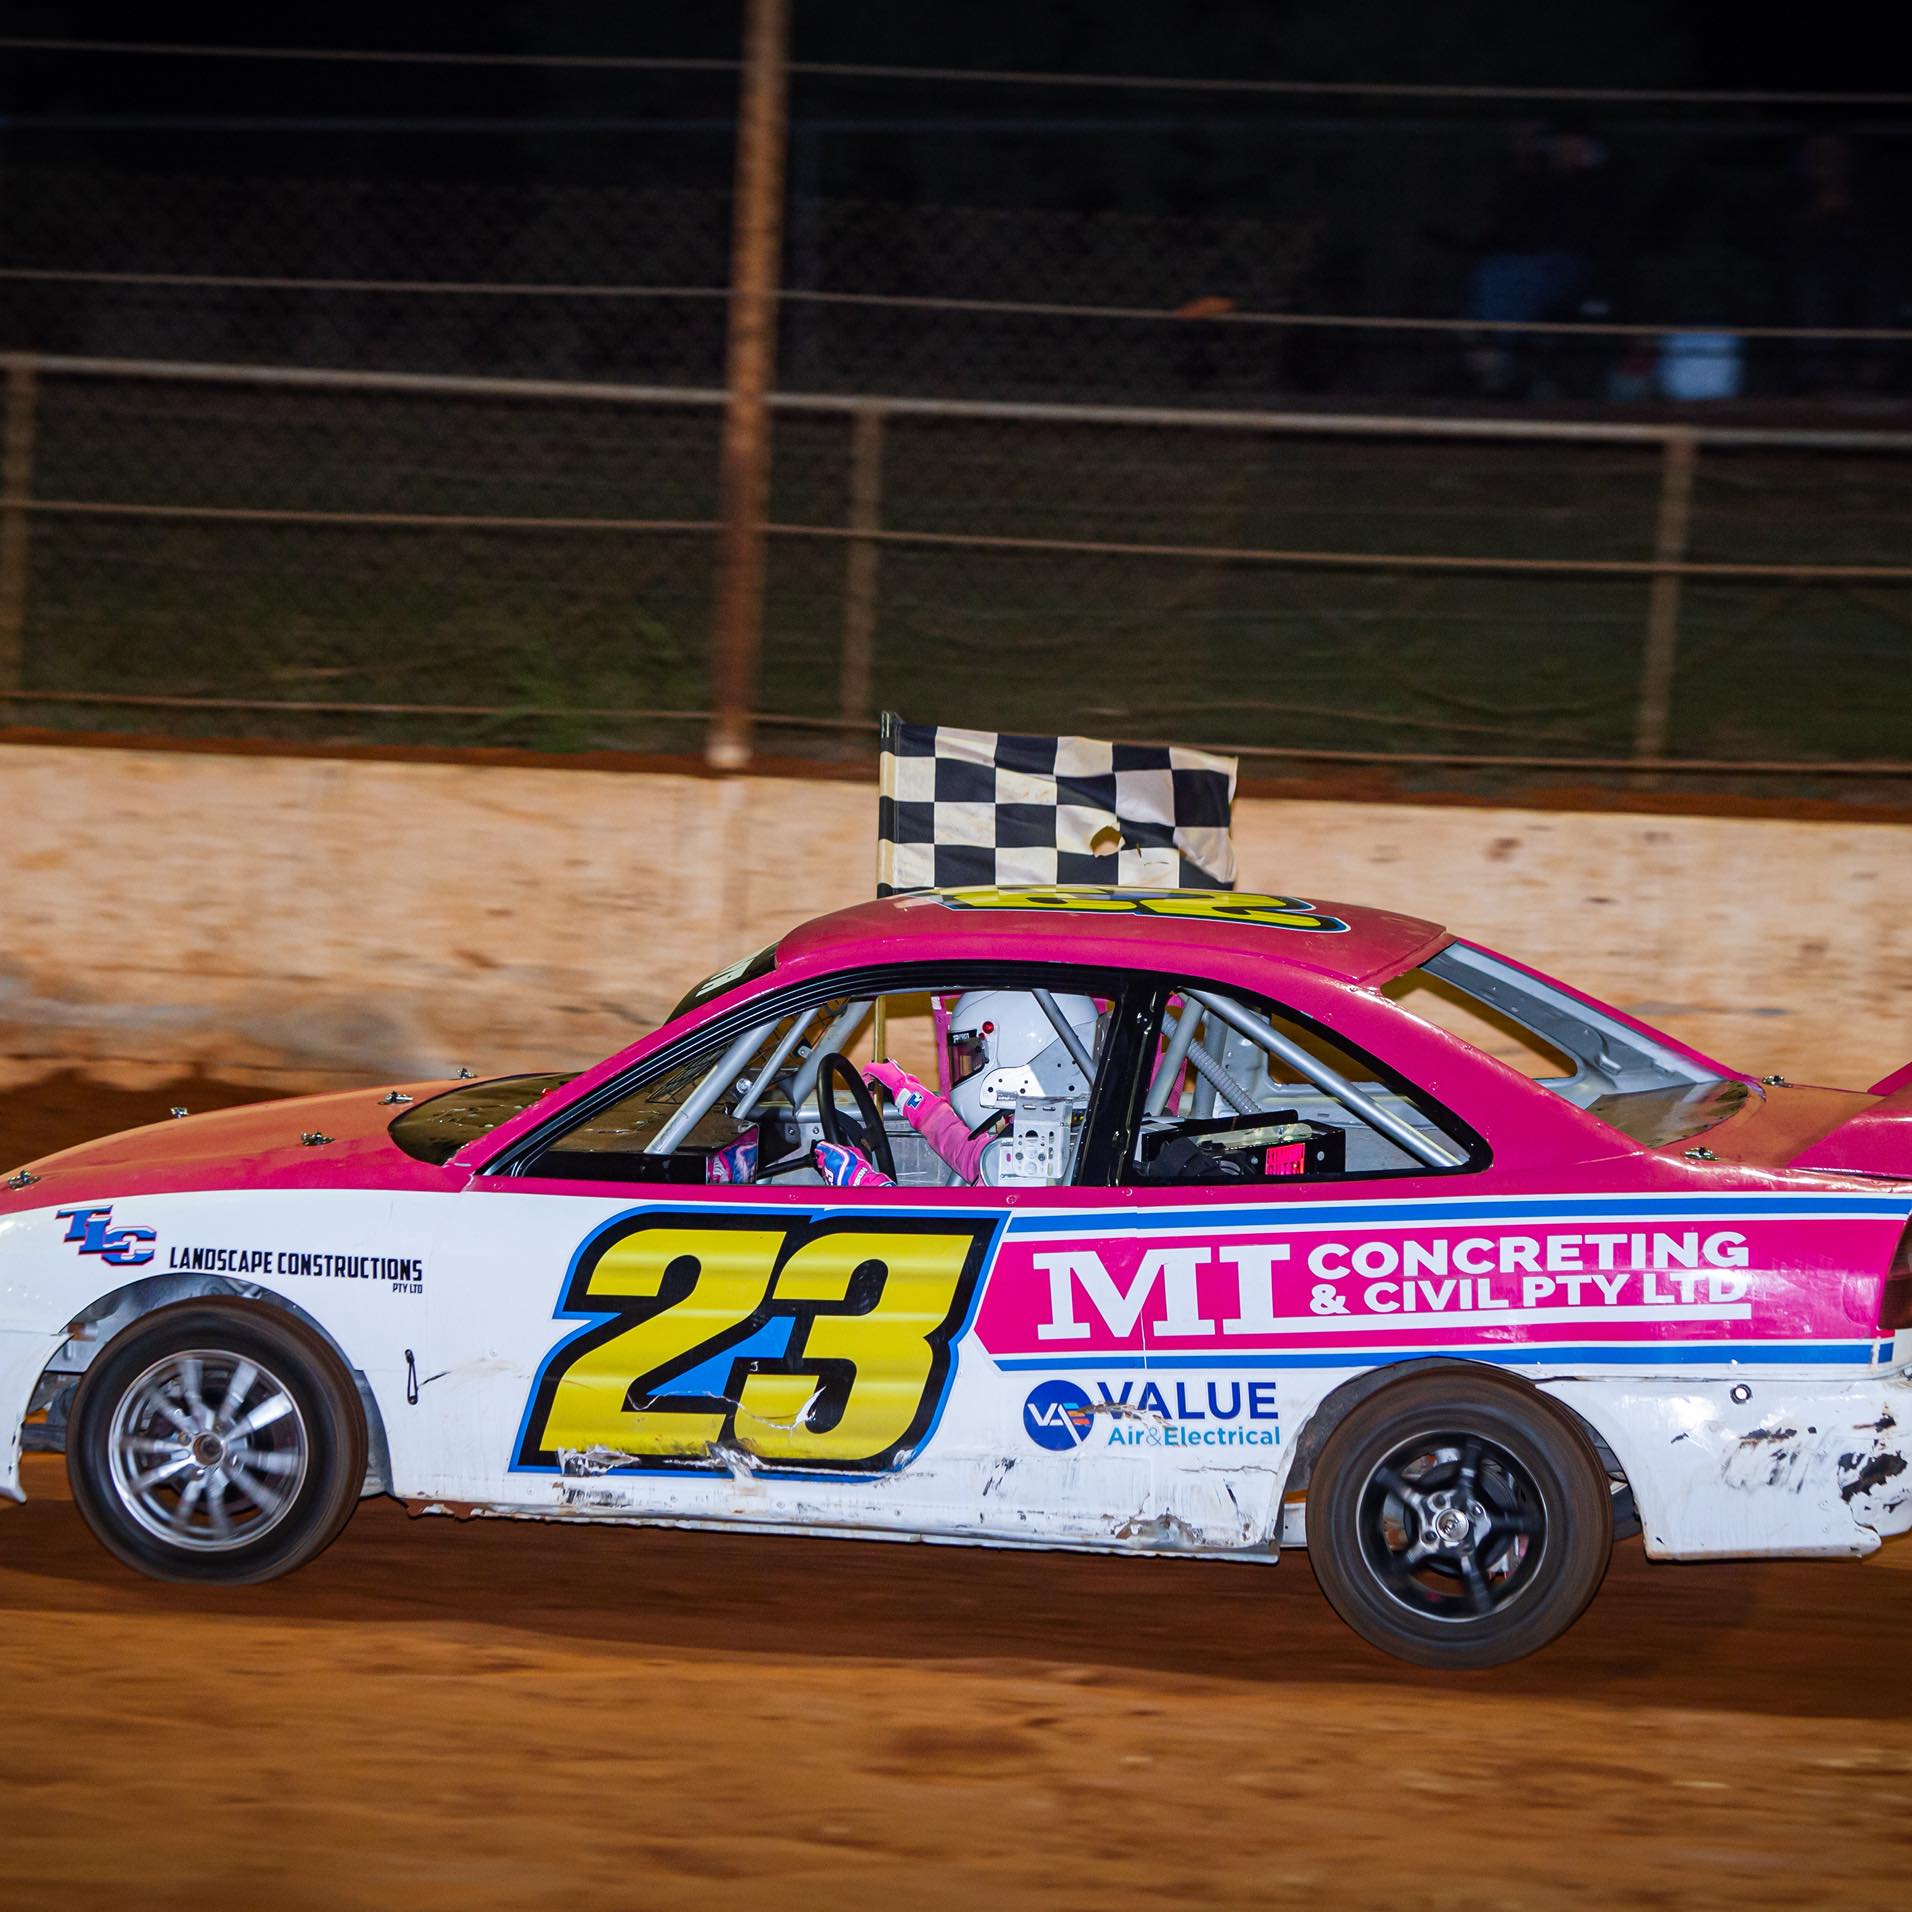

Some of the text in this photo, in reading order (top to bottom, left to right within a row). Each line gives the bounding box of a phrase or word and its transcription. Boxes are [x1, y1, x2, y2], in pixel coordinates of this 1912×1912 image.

[55, 1204, 157, 1267] TLC
[1307, 1231, 1750, 1280] CONCRETING
[169, 1246, 424, 1282] LANDSCAPE CONSTRUCTIONS
[392, 1282, 424, 1294] PTY LTD
[1032, 1243, 1291, 1341] MI
[1310, 1271, 1748, 1315] & CIVIL PTY LTD
[519, 1211, 999, 1474] 23
[1096, 1381, 1279, 1420] VALUE
